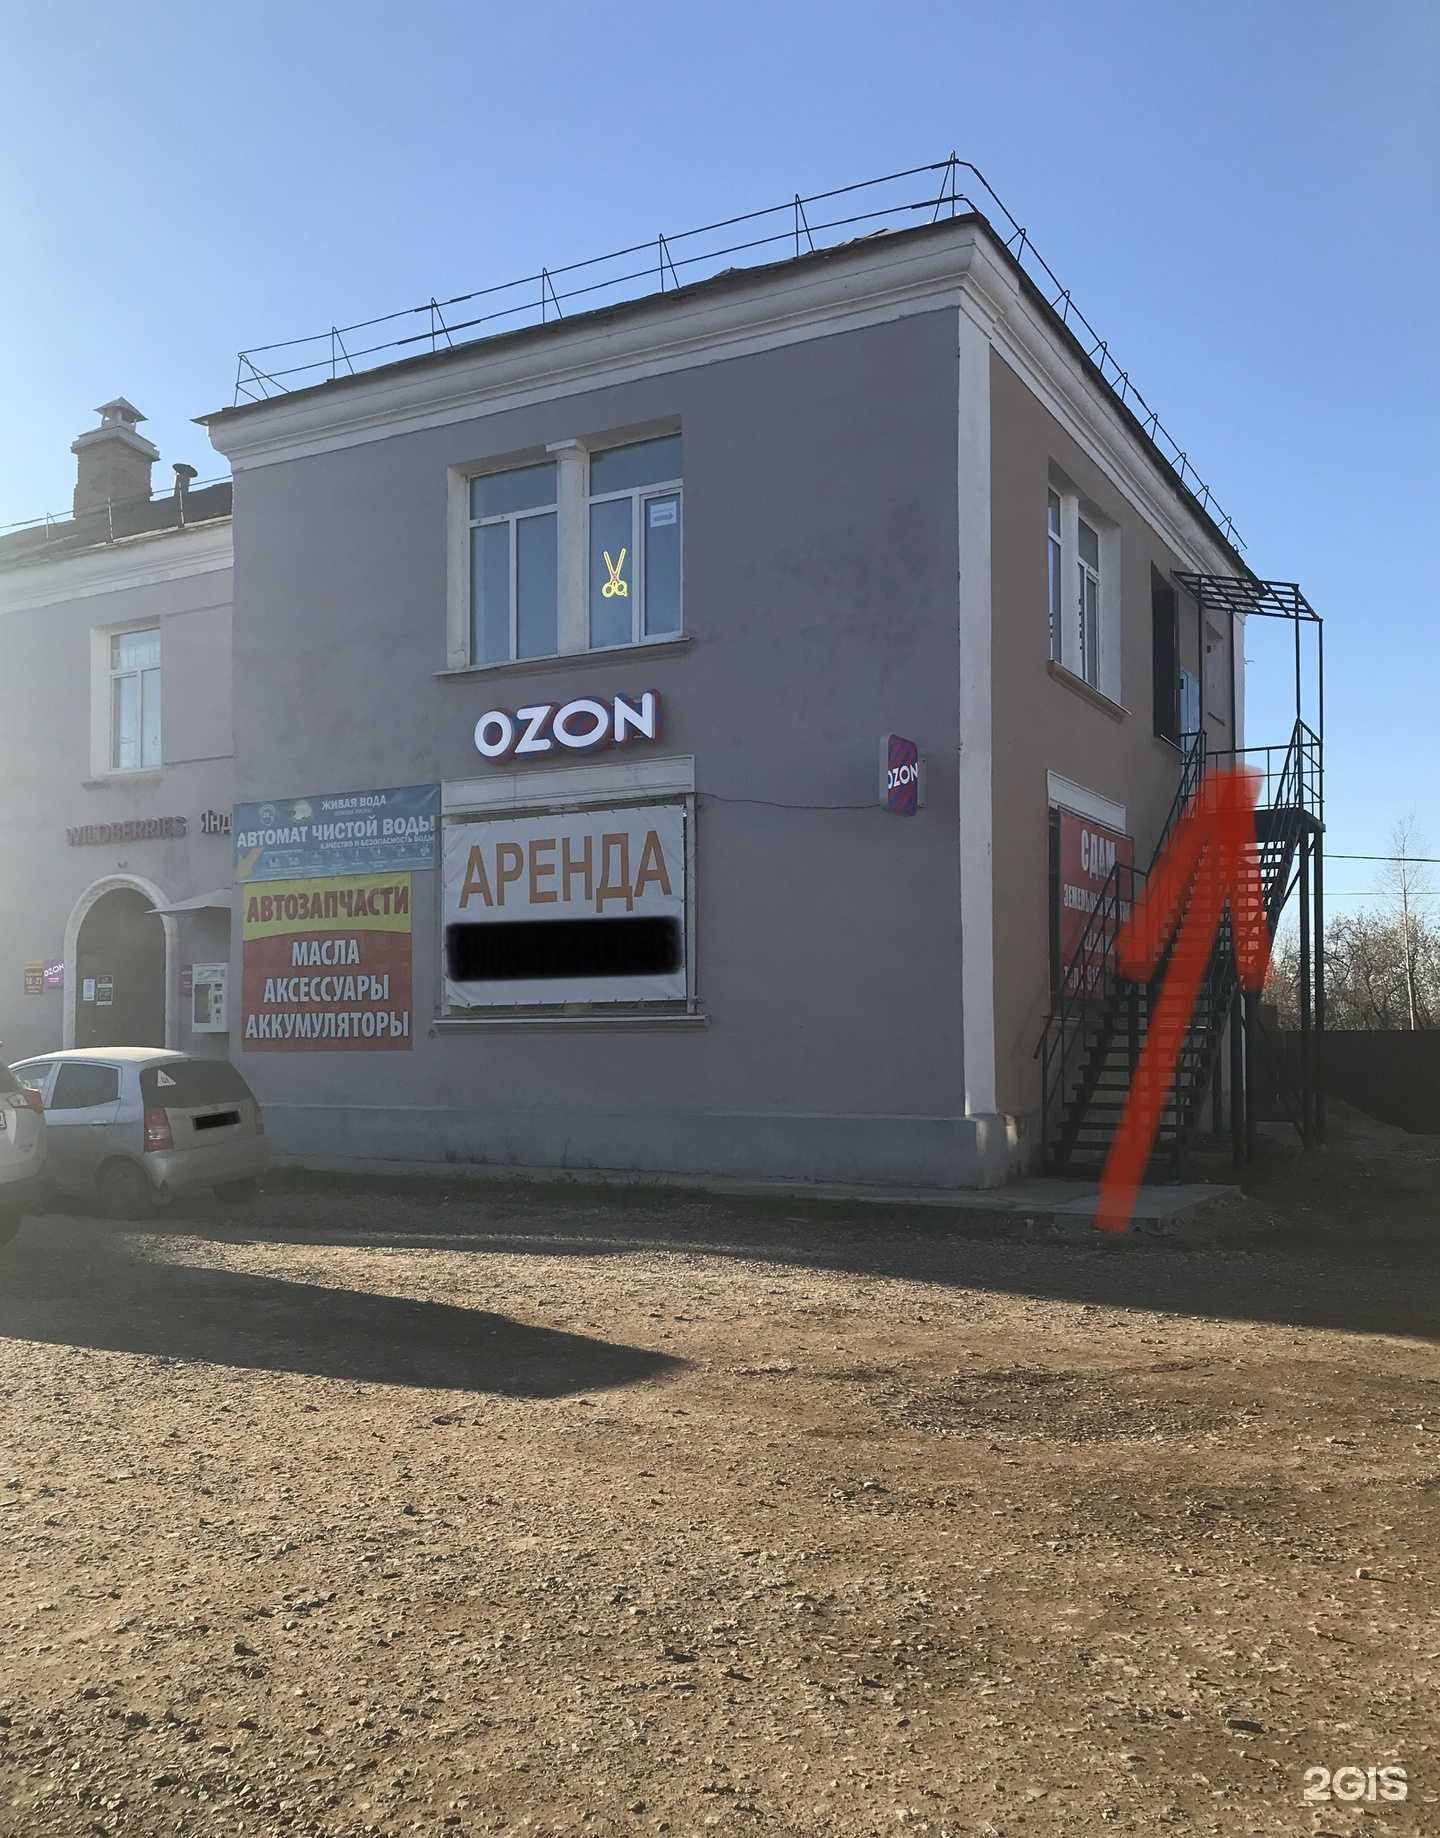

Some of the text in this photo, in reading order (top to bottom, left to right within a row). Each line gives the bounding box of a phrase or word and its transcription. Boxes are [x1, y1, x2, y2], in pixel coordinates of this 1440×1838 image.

[473, 691, 658, 758] OZON
[321, 794, 387, 811] ЖИВАЯ ВОДА
[237, 826, 309, 848] АВТОМАТ
[311, 815, 378, 841] ЧИСТОЙ
[458, 830, 673, 914] АРЕНДА
[246, 886, 410, 923] АВТОЗАПЧАСТИ
[291, 939, 360, 966] МАСЛА
[263, 975, 389, 1003] АКСЕССУАРЫ
[245, 1010, 409, 1039] АККУМУЛЯТОРЫ
